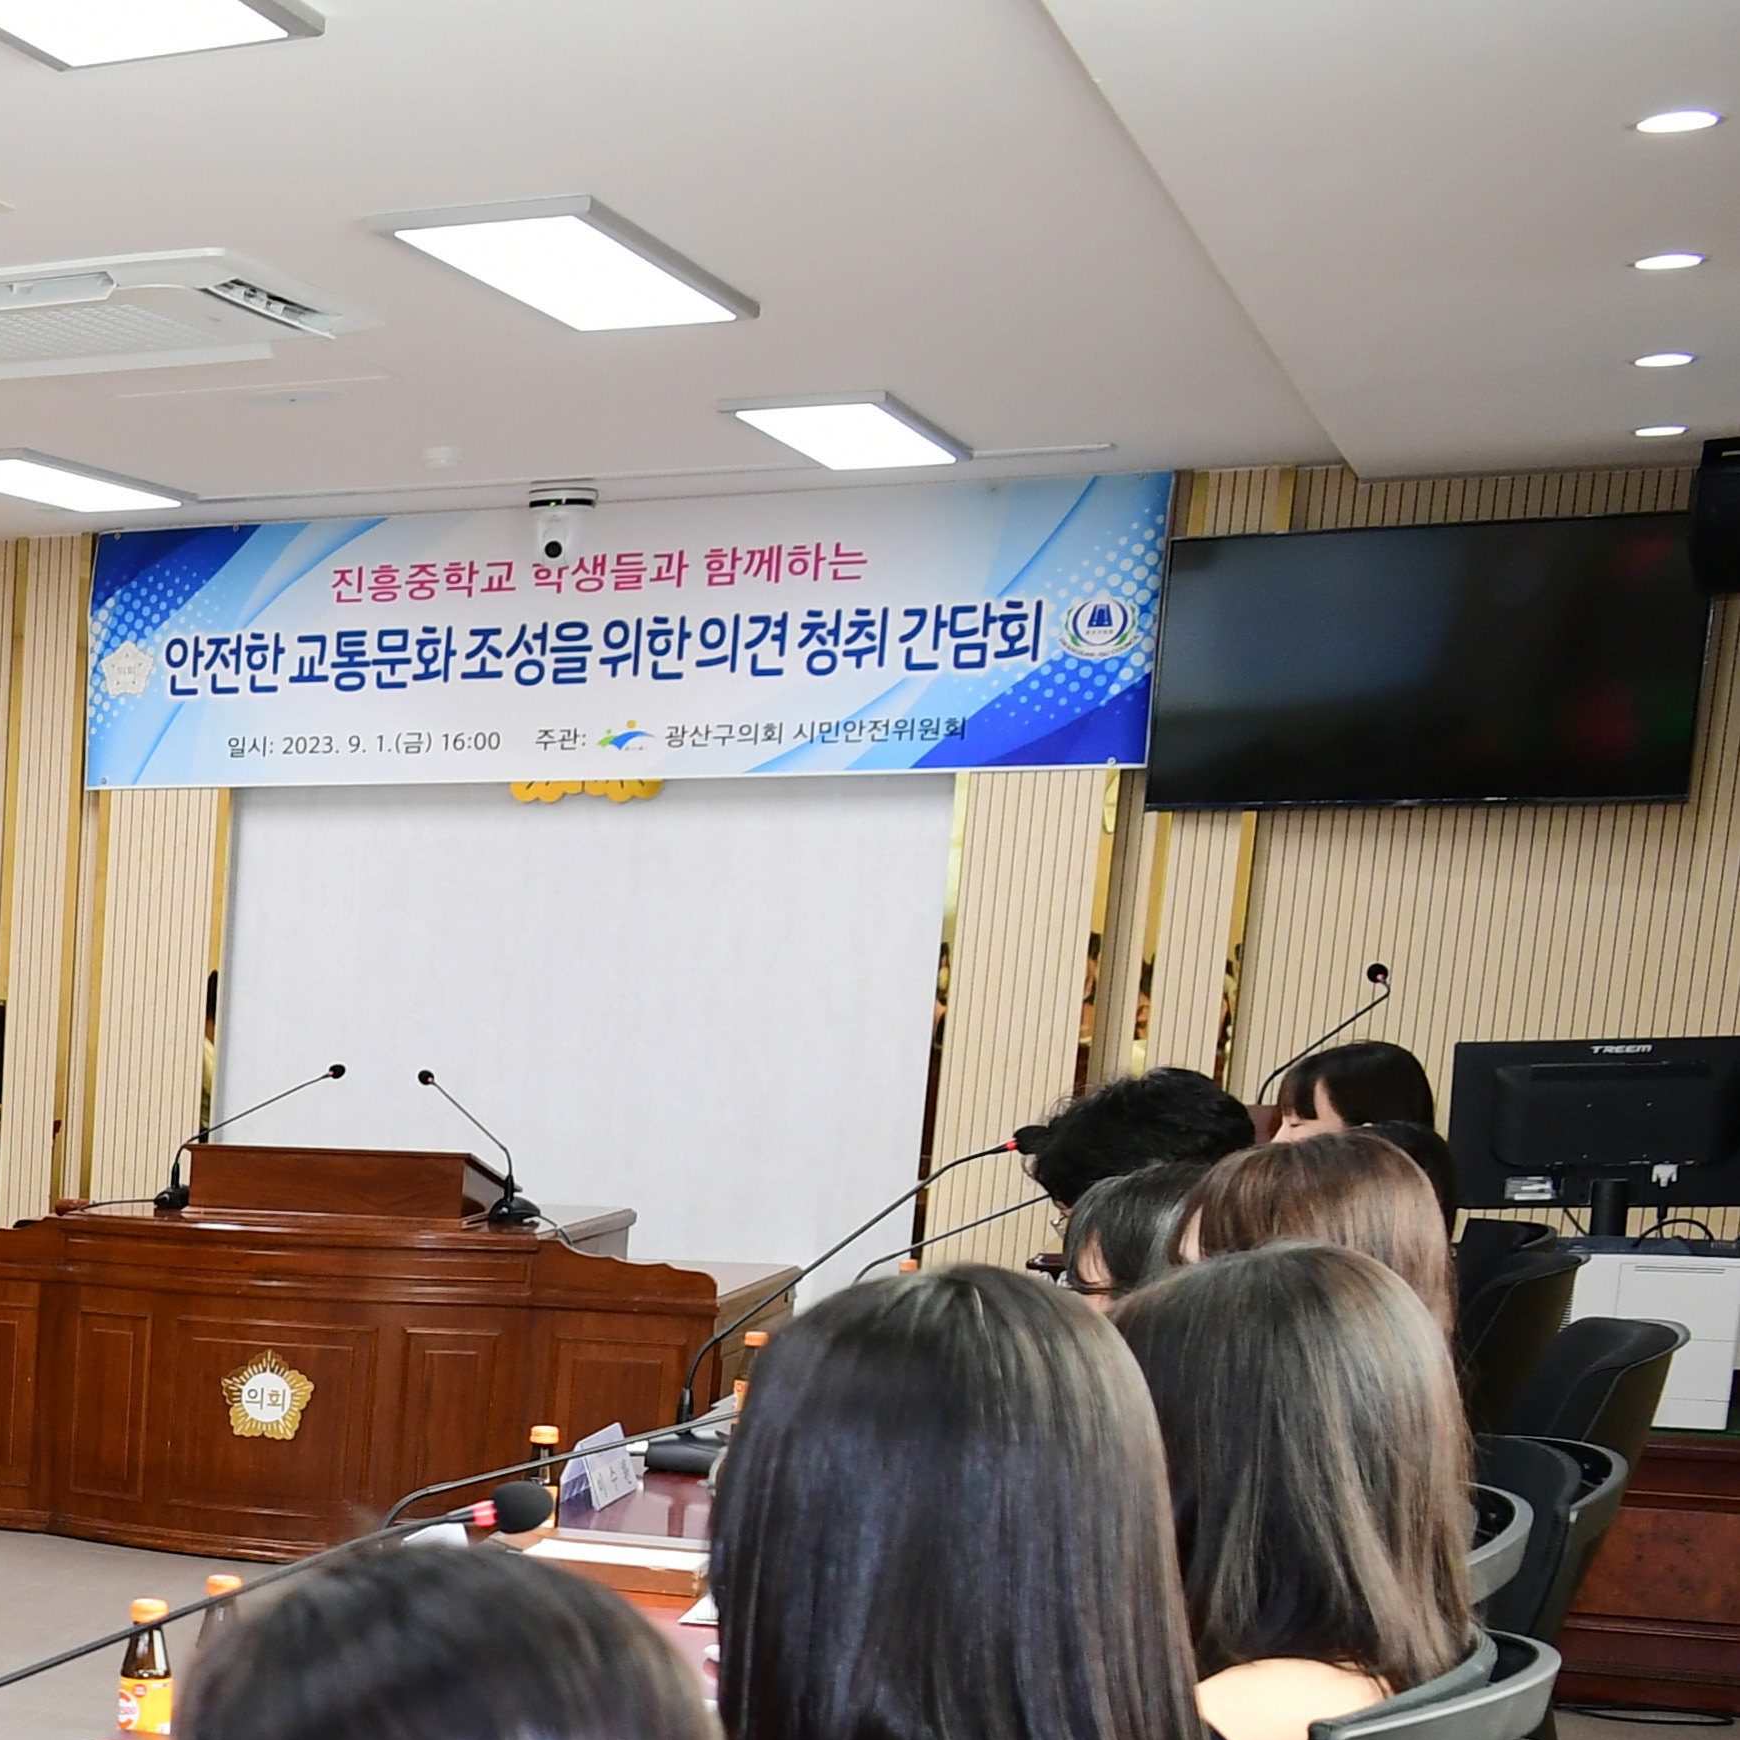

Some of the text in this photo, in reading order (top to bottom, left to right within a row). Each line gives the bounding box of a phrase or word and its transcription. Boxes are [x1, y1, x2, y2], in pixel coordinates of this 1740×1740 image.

[330, 558, 517, 604] 진흥중학교
[704, 541, 870, 588] 함께하는
[165, 599, 1043, 696] 안전한 교통문화 조성을 위한 의견 청취 간담회
[226, 734, 275, 759] 일시:
[281, 735, 341, 756] 2023.
[347, 734, 368, 754] 9.
[441, 731, 502, 752] 16:00
[534, 726, 587, 752] 주관:
[664, 722, 784, 749] 광산구의회
[791, 716, 968, 744] 시민안전위원회
[245, 1387, 286, 1412] 의회
